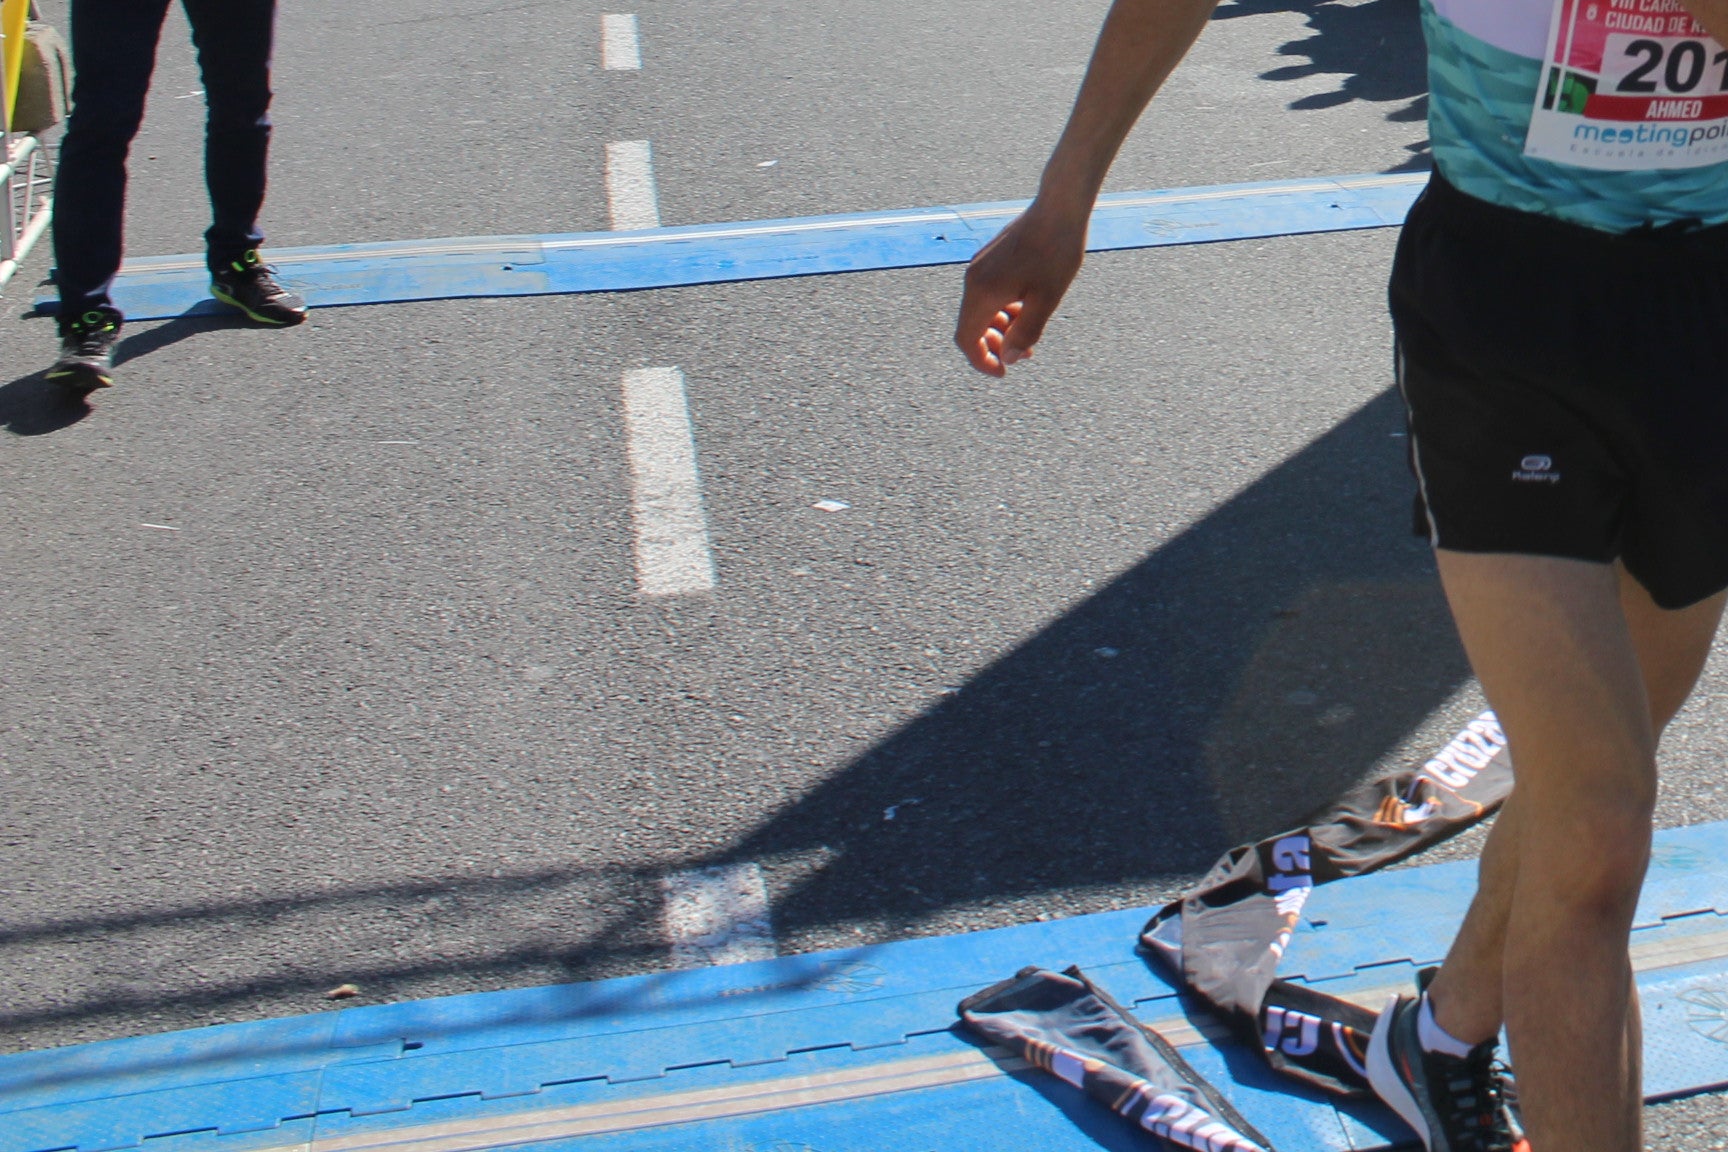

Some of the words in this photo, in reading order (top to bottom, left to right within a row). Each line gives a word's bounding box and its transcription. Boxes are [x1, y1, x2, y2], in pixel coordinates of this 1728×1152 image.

[1605, 11, 1665, 34] CIUDAD
[1668, 16, 1687, 34] DE
[1645, 100, 1703, 119] AHMED
